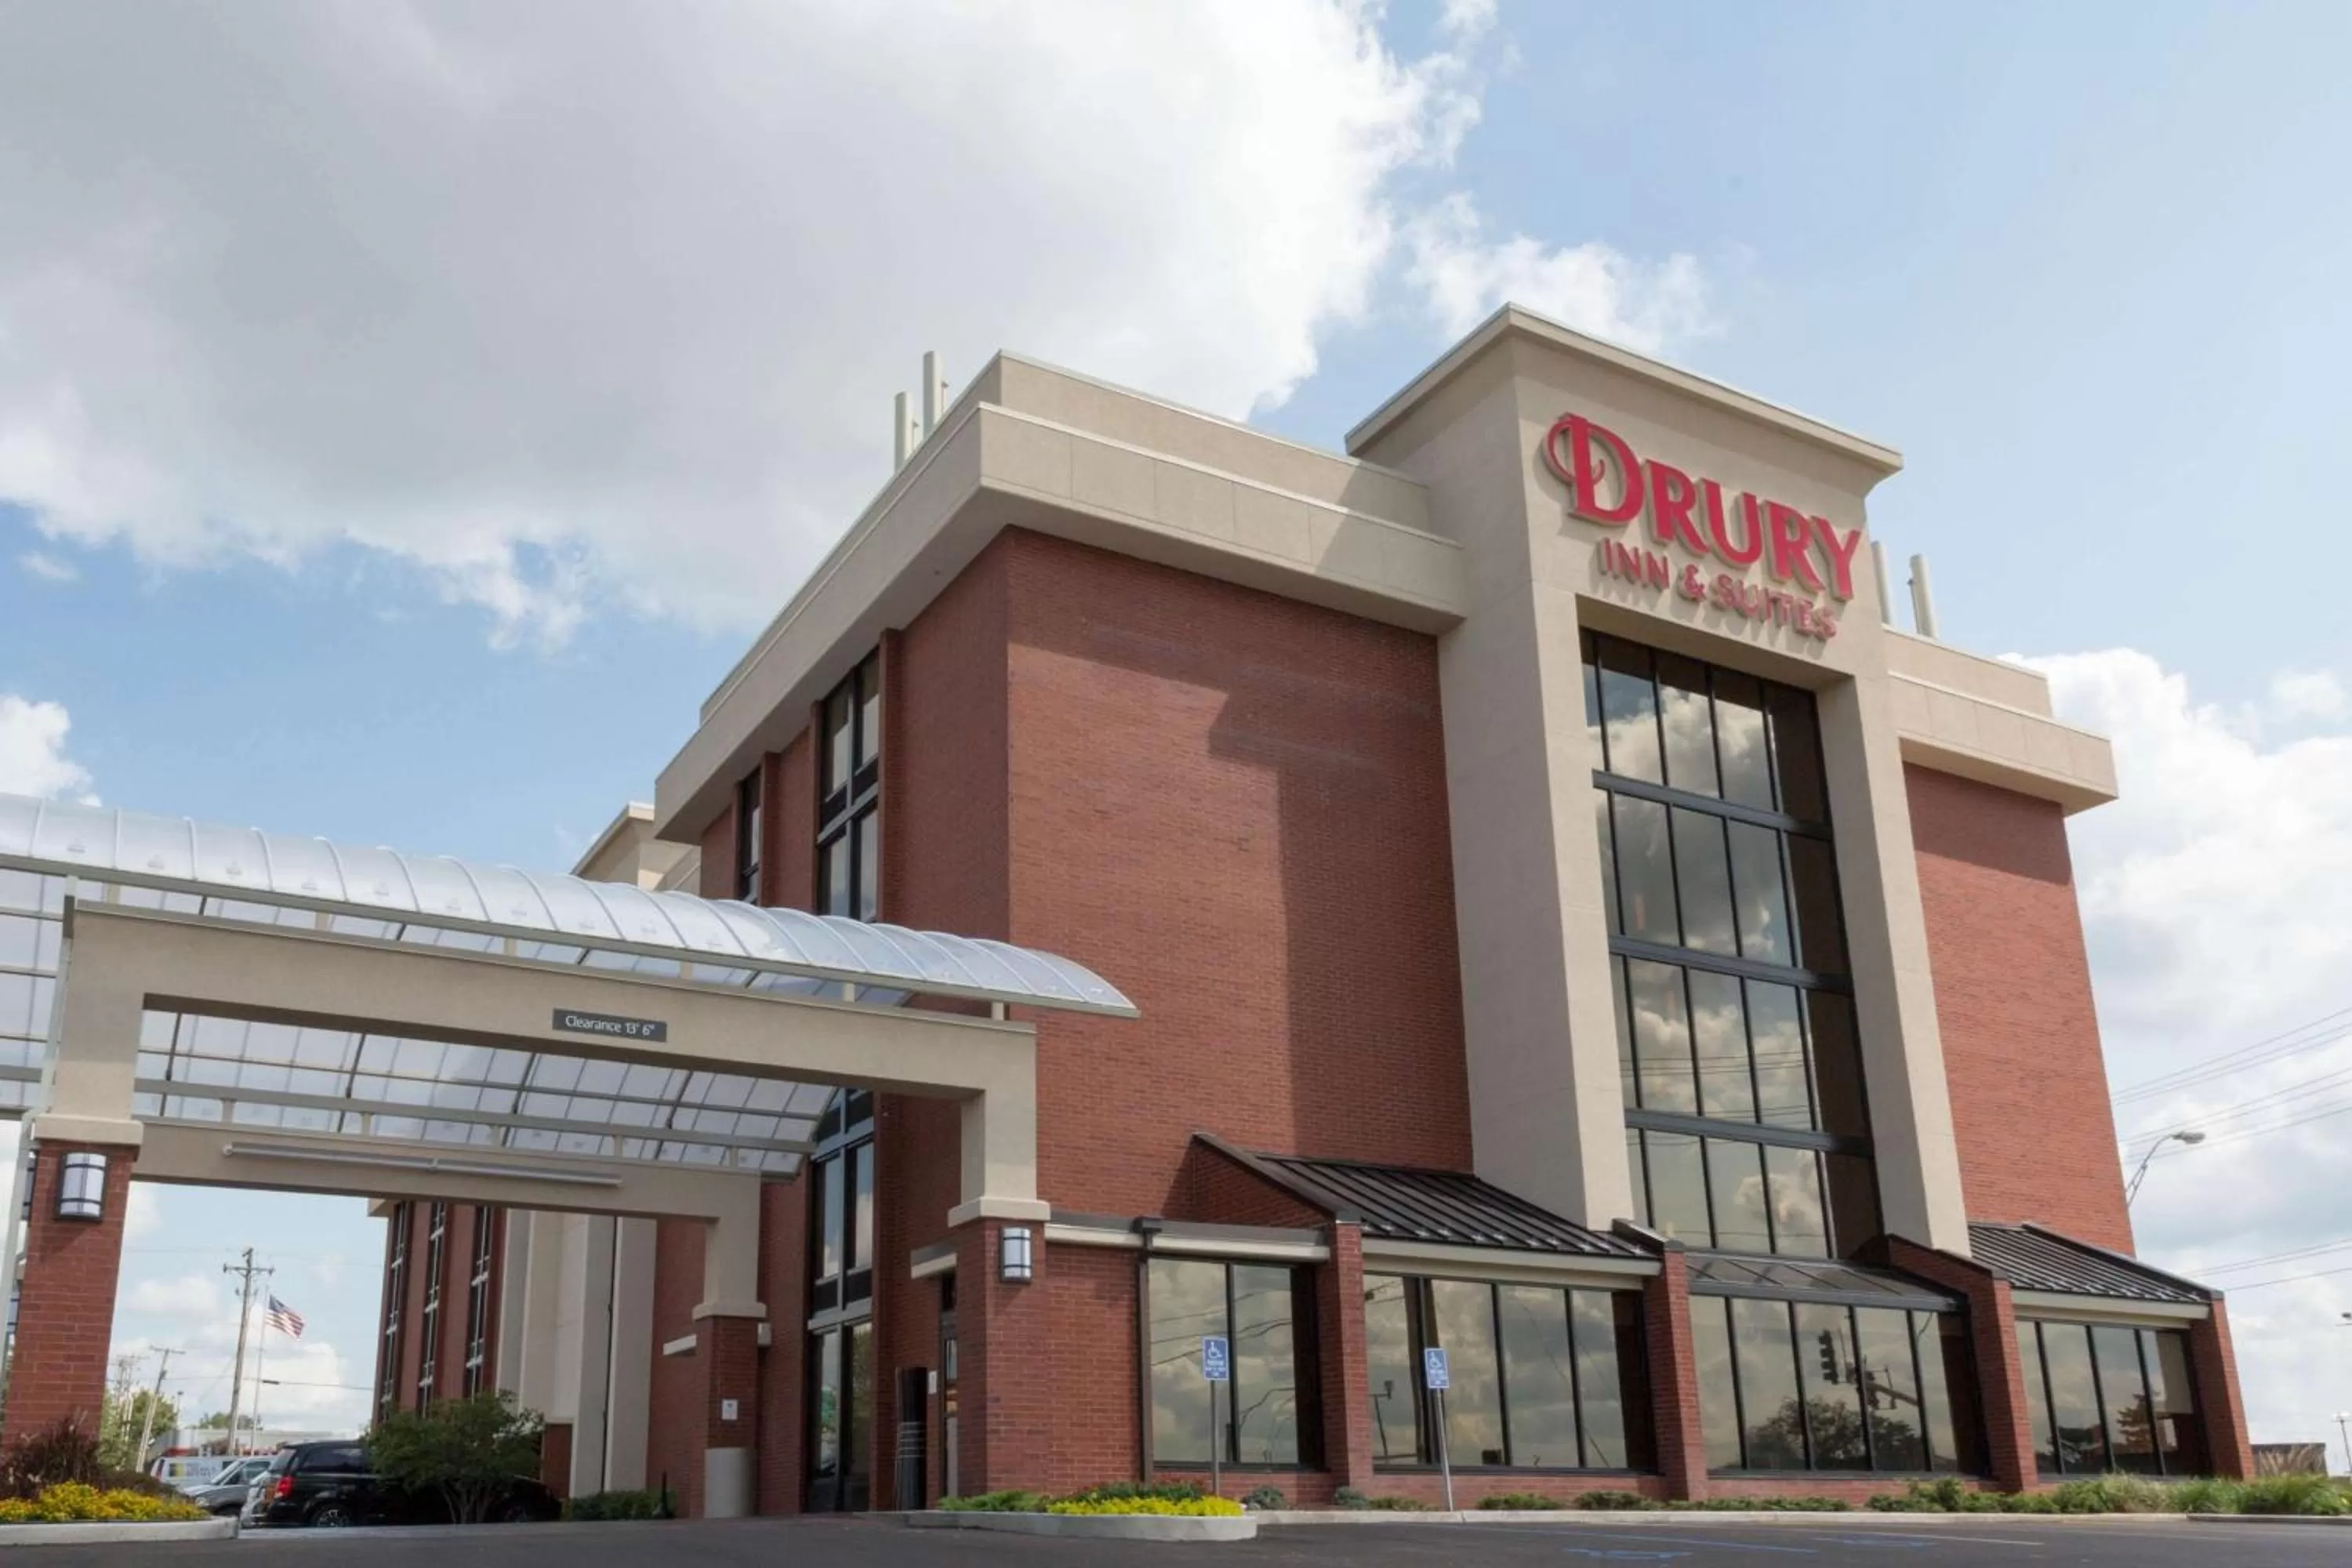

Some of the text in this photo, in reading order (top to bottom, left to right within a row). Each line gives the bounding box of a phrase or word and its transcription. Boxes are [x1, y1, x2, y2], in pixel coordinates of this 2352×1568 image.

[1542, 412, 1861, 602] DRURY
[1597, 537, 1837, 641] INN & SUITES
[565, 1015, 622, 1033] Clearance
